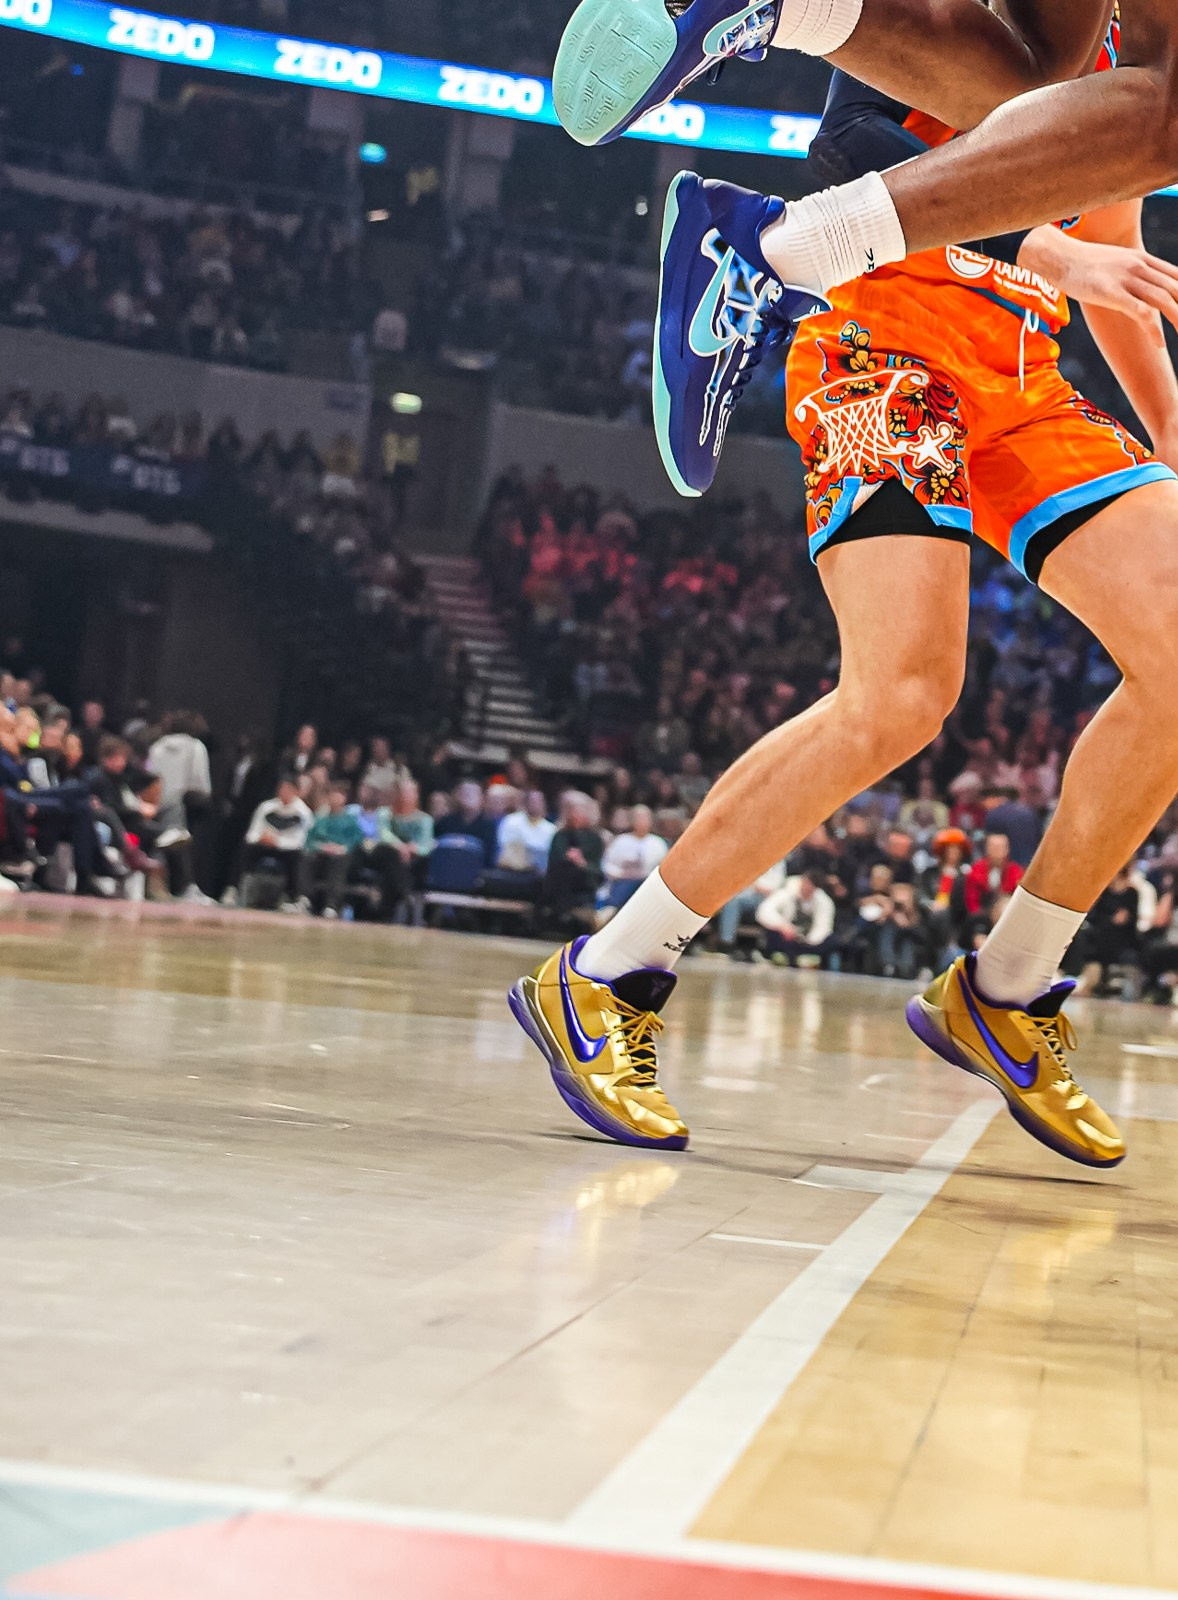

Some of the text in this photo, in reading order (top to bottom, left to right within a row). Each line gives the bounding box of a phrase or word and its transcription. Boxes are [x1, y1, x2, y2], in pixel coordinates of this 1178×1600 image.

[107, 8, 215, 60] ZEDO
[274, 39, 382, 88] ZEDO
[438, 66, 544, 114] ZEDO
[630, 103, 705, 139] DO
[768, 115, 821, 151] ZE
